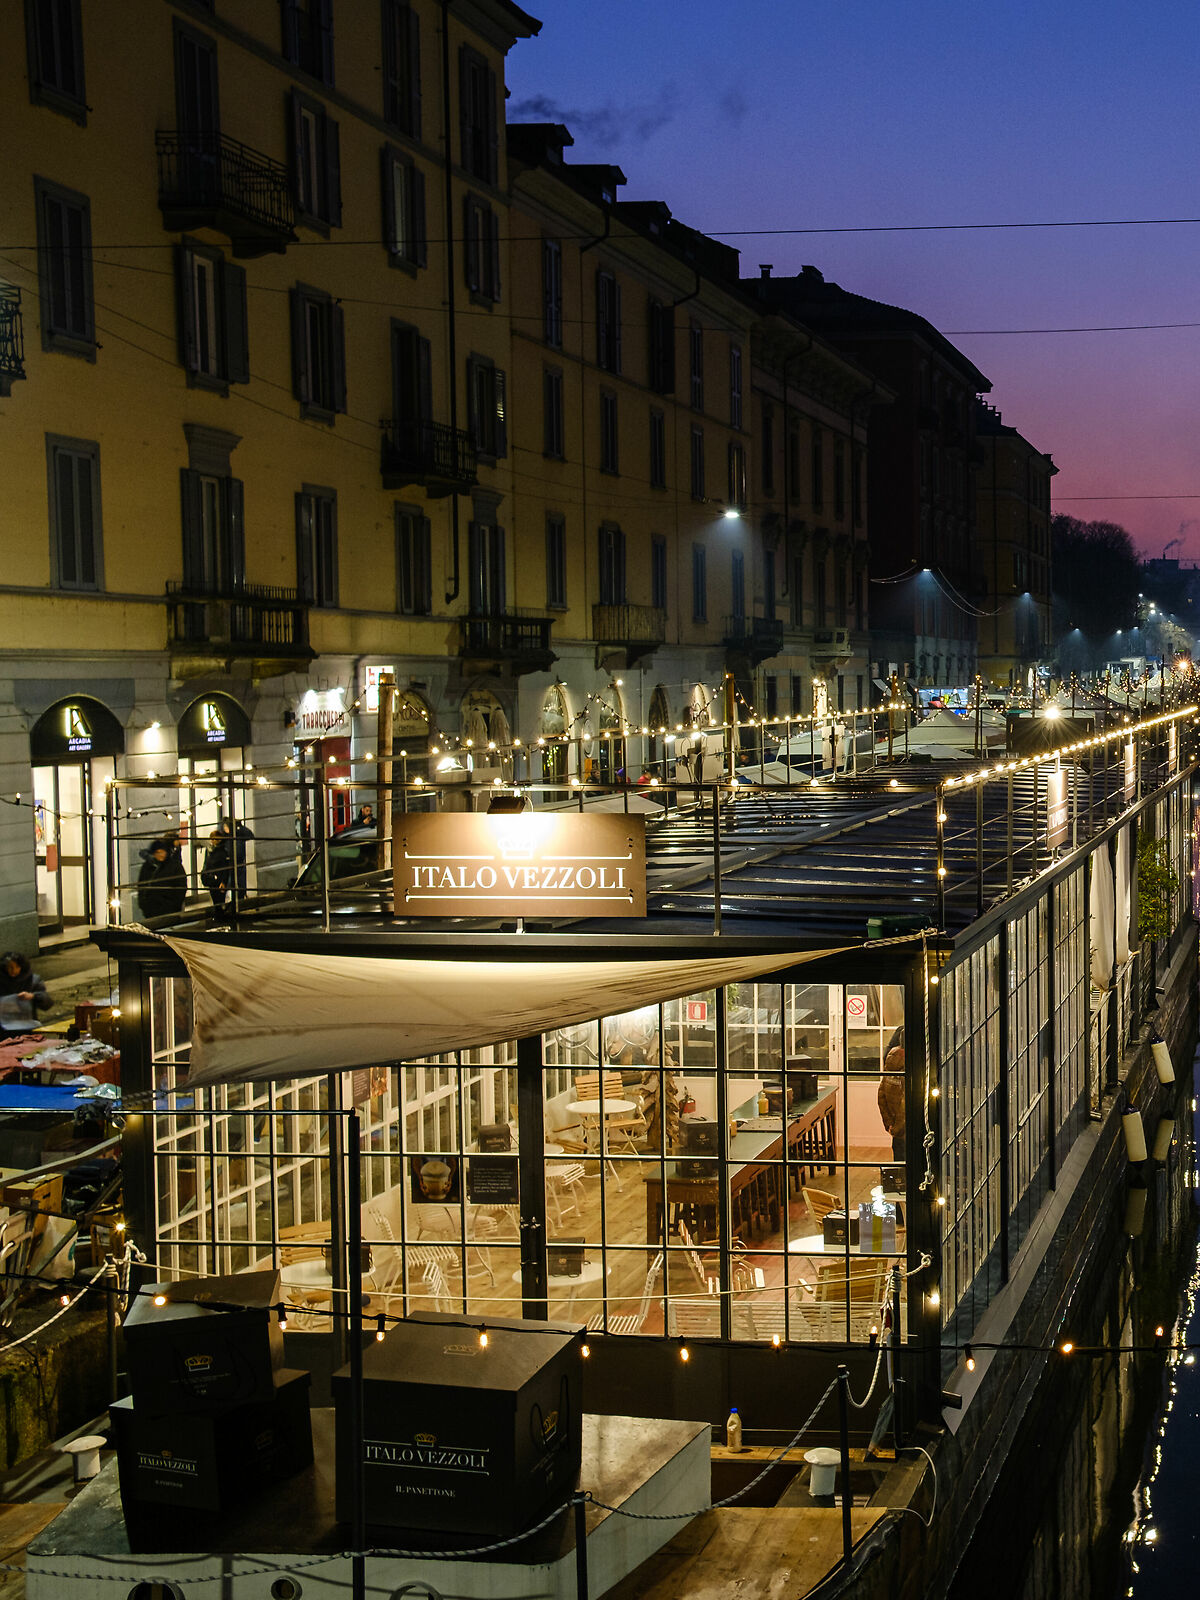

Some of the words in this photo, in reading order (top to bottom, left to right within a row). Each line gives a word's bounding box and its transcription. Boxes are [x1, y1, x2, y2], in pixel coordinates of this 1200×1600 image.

[412, 866, 497, 889] ITALO
[502, 866, 627, 890] VEZZOLI
[162, 1459, 197, 1473] VEZZOLI
[366, 1446, 414, 1463] ITALO
[418, 1450, 486, 1469] VEZZOLI
[406, 1486, 456, 1498] PANETTONE
